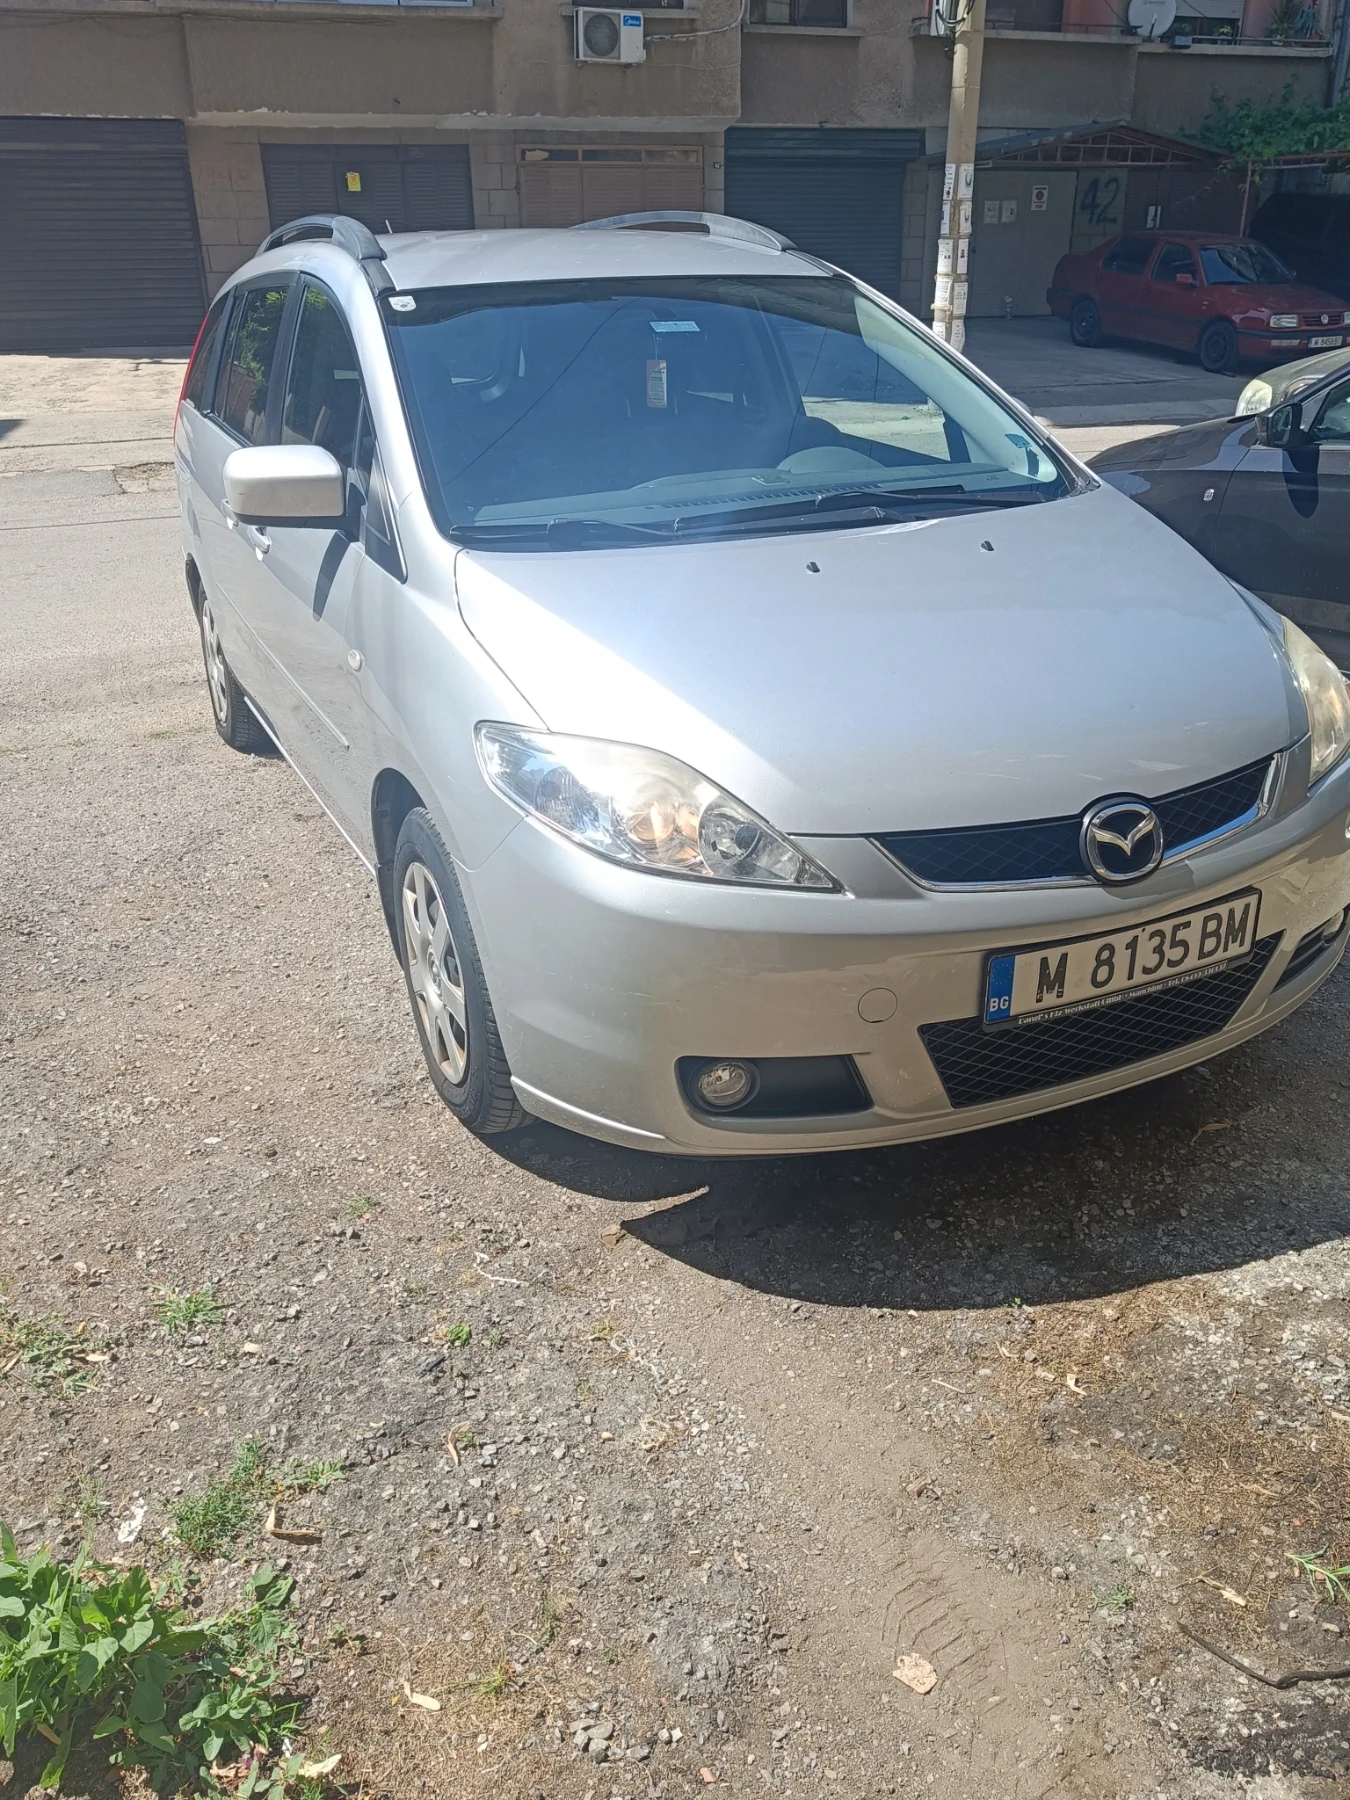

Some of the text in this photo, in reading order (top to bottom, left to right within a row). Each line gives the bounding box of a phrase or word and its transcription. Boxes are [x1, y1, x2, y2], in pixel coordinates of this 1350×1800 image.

[1080, 177, 1118, 225] 42
[1035, 902, 1251, 1004] M 8135 BM
[989, 995, 1009, 1012] BG
